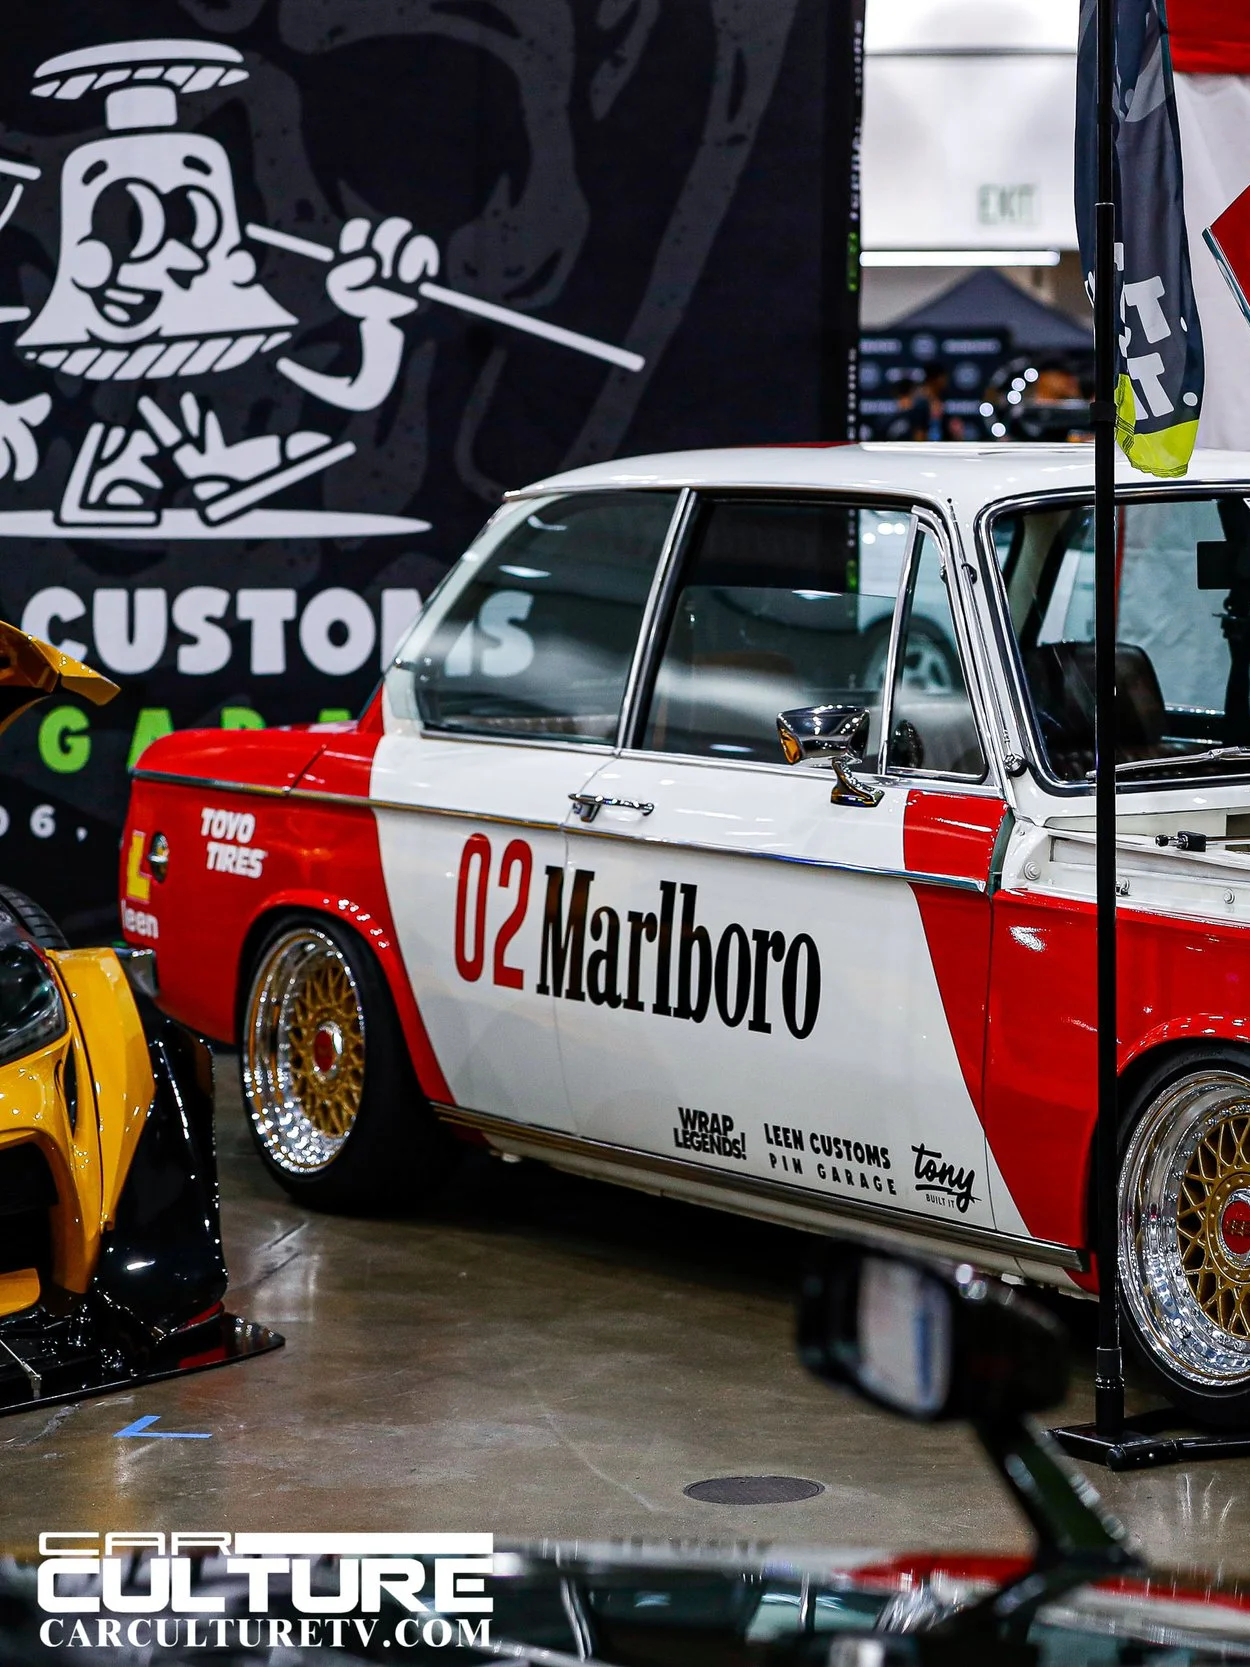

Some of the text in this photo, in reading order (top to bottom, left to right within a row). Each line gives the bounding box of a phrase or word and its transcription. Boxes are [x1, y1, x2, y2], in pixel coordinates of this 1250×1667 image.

[201, 807, 256, 844] TOYO
[206, 841, 263, 879] TIRES
[454, 832, 822, 1040] 02 Marlboro
[678, 1106, 734, 1137] WRAP
[673, 1127, 747, 1161] LEGENDS!
[764, 1123, 892, 1170] LEEN CUSTOMS
[769, 1152, 897, 1196] PIN GARAGE
[911, 1143, 981, 1213] tony
[926, 1193, 946, 1207] BUILT
